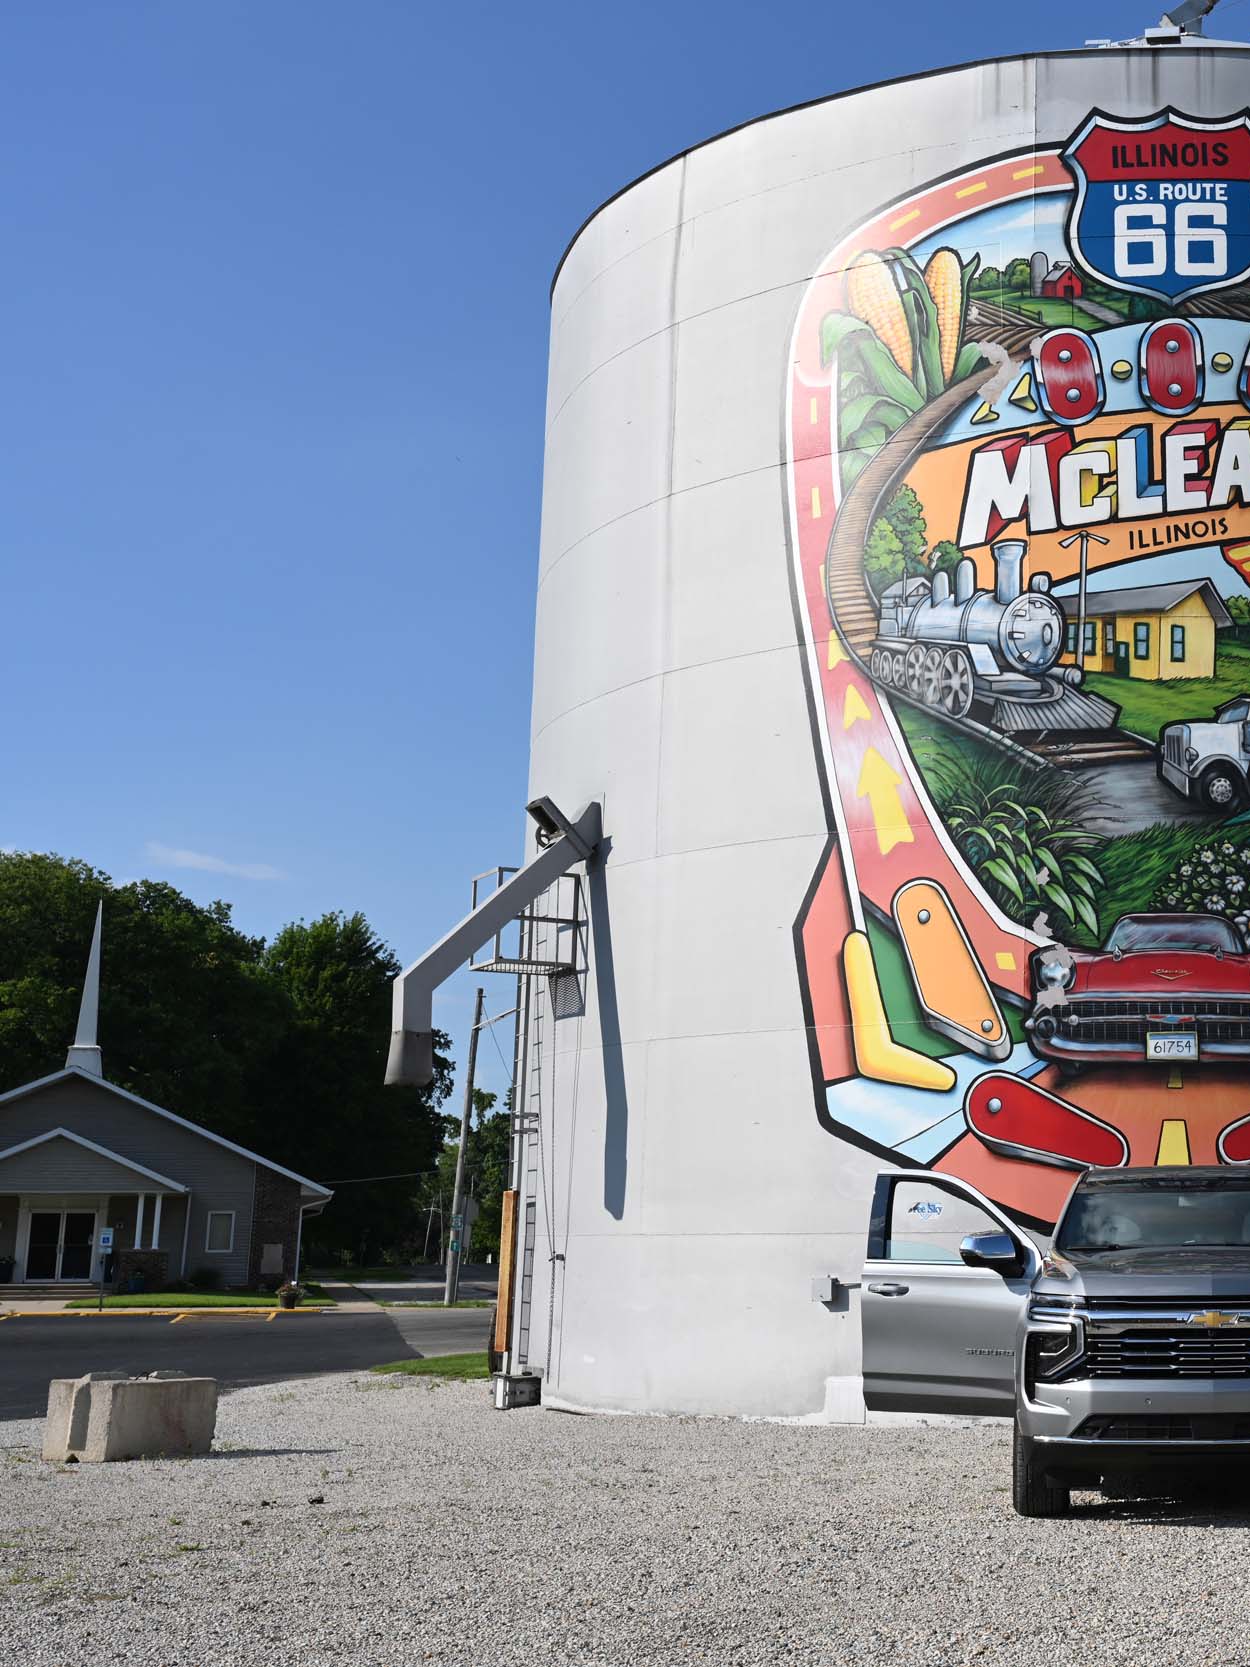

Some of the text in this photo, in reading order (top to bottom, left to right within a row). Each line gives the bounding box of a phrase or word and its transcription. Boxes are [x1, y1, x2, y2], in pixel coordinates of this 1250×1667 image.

[1112, 142, 1229, 169] ILLINOIS
[1113, 184, 1228, 201] U.S. ROUTE
[1114, 203, 1228, 277] 66
[1129, 517, 1229, 550] ILLINOIS
[1153, 1040, 1192, 1054] 61754
